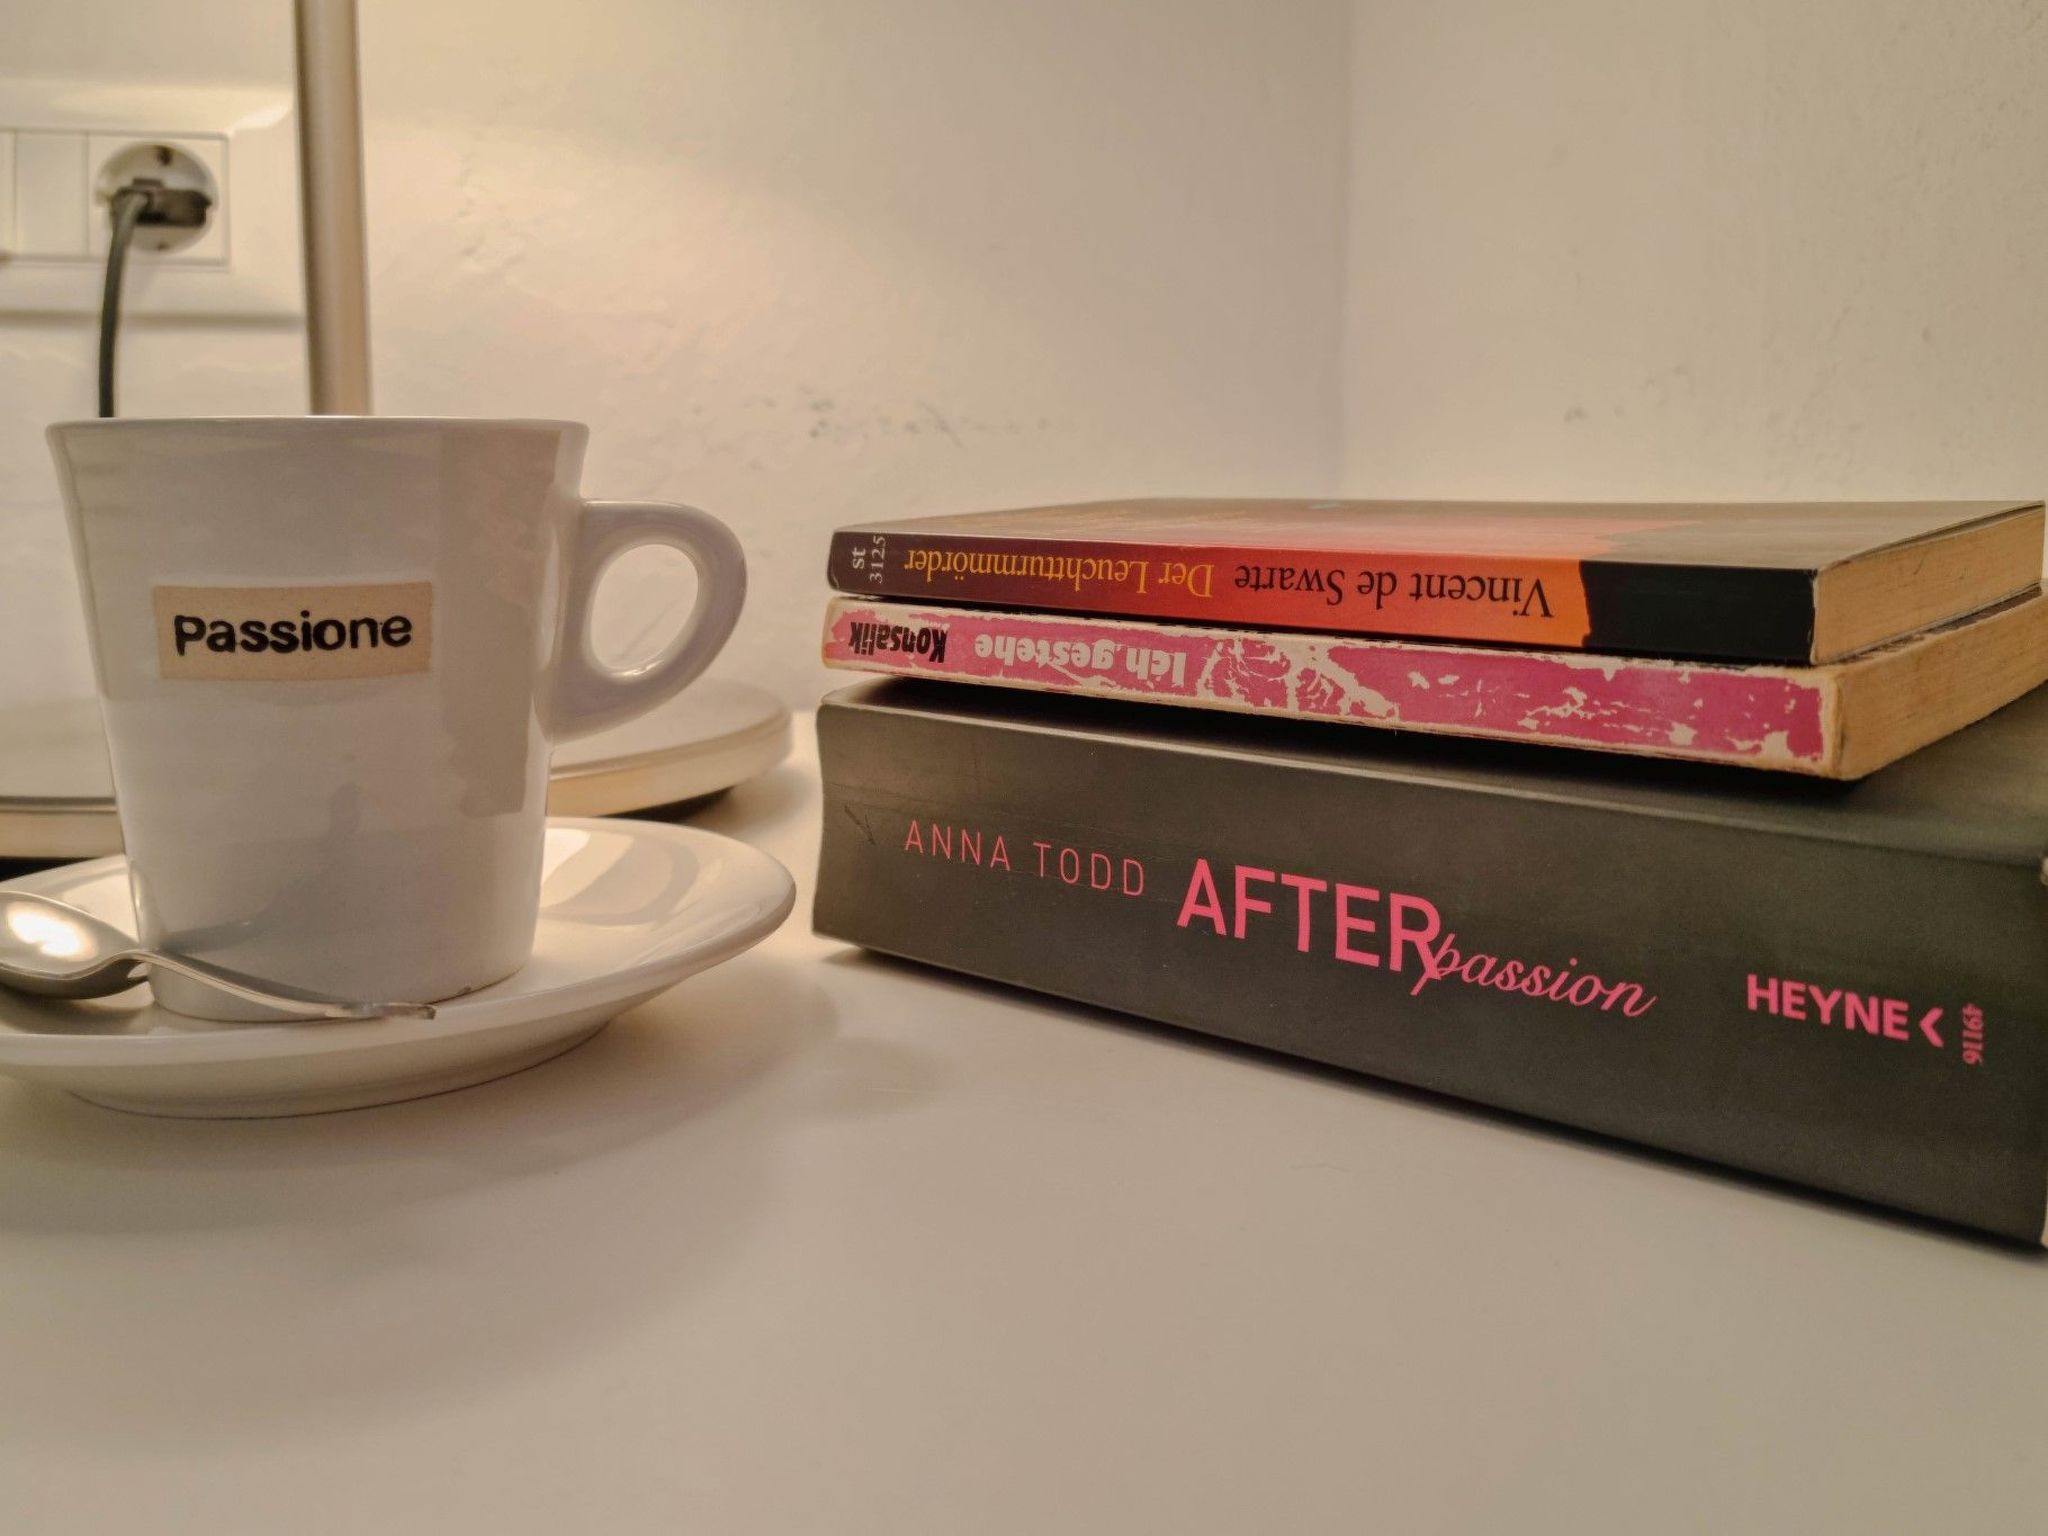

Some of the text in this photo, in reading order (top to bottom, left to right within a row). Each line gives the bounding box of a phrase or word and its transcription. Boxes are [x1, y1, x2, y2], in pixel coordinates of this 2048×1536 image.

[851, 546, 867, 570] st
[869, 535, 886, 585] 3125
[904, 549, 1215, 598] Der Leuchtturmmörder
[1233, 564, 1555, 619] Vincent de Swarte
[848, 621, 949, 664] Konsalik
[974, 633, 1187, 688] Ich gestehe
[904, 819, 1145, 897] ANNA TODD
[1176, 858, 1659, 1018] AFTER passion
[1746, 972, 1911, 1041] HEYNE
